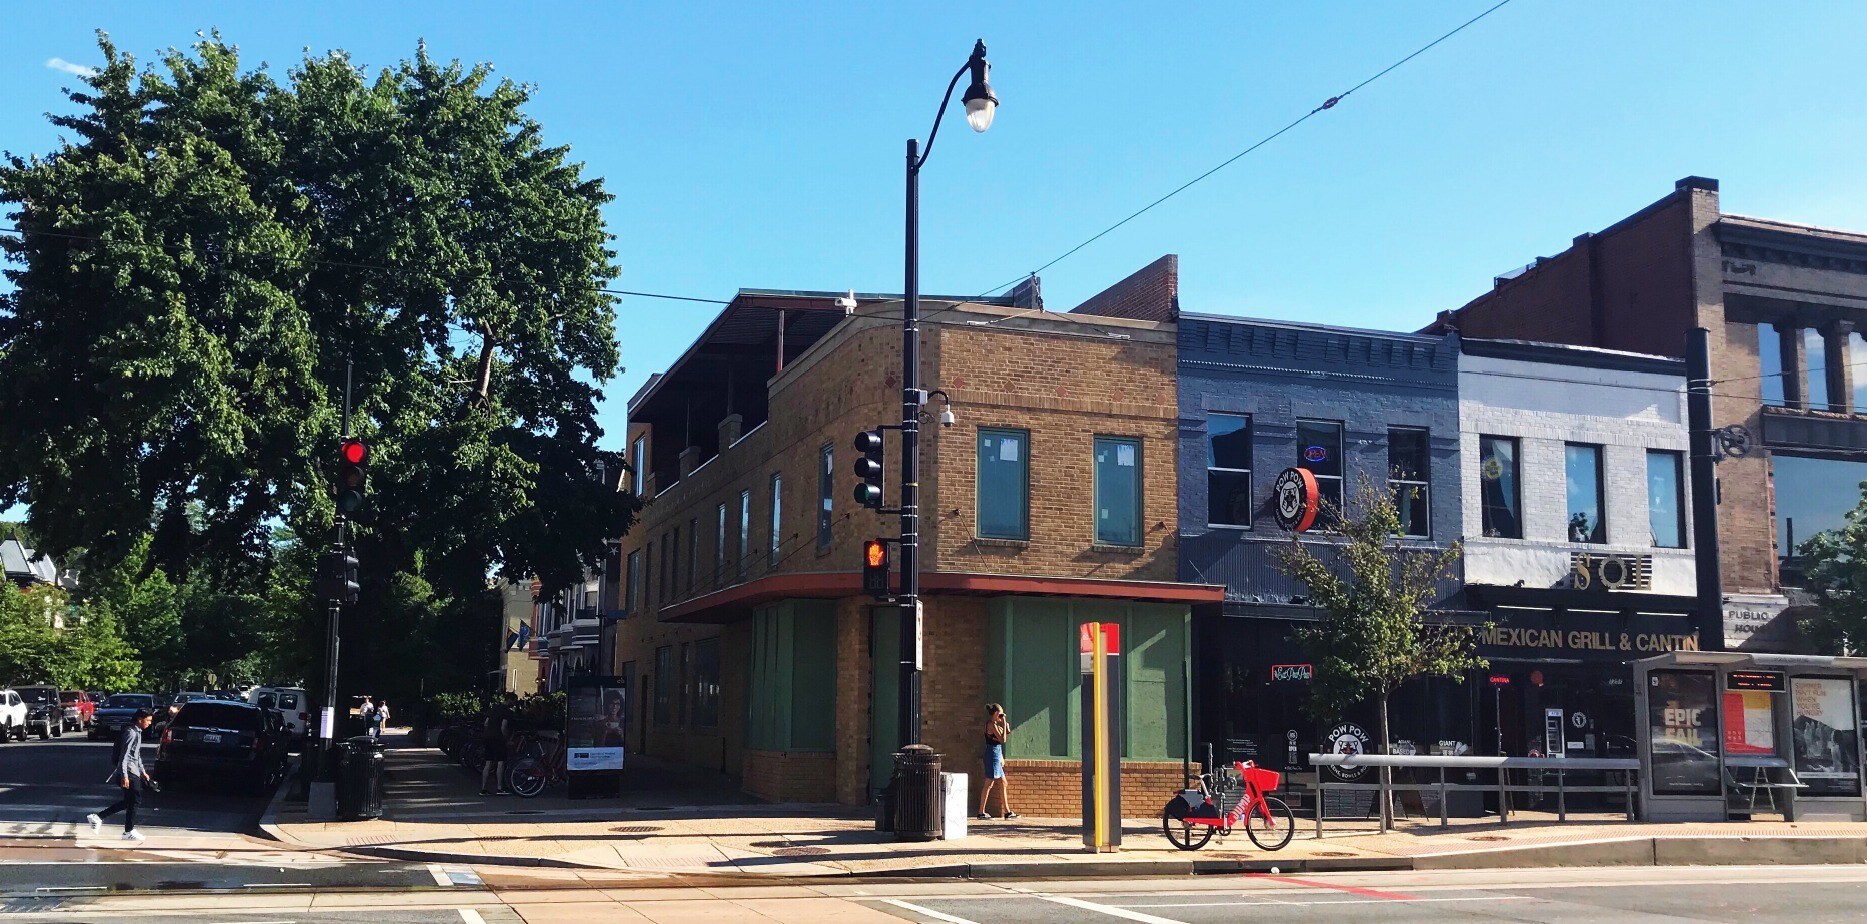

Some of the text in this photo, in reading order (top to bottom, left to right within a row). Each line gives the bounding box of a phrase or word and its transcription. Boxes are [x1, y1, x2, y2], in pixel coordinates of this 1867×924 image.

[1275, 471, 1304, 493] POW POW
[1574, 552, 1651, 590] SOL
[1728, 610, 1769, 621] PUBLIC
[1482, 627, 1563, 648] MEXICAN
[1567, 631, 1615, 650] GRILL
[1619, 632, 1631, 650] &
[1664, 708, 1702, 727] EPIC
[1328, 725, 1369, 742] POW POW
